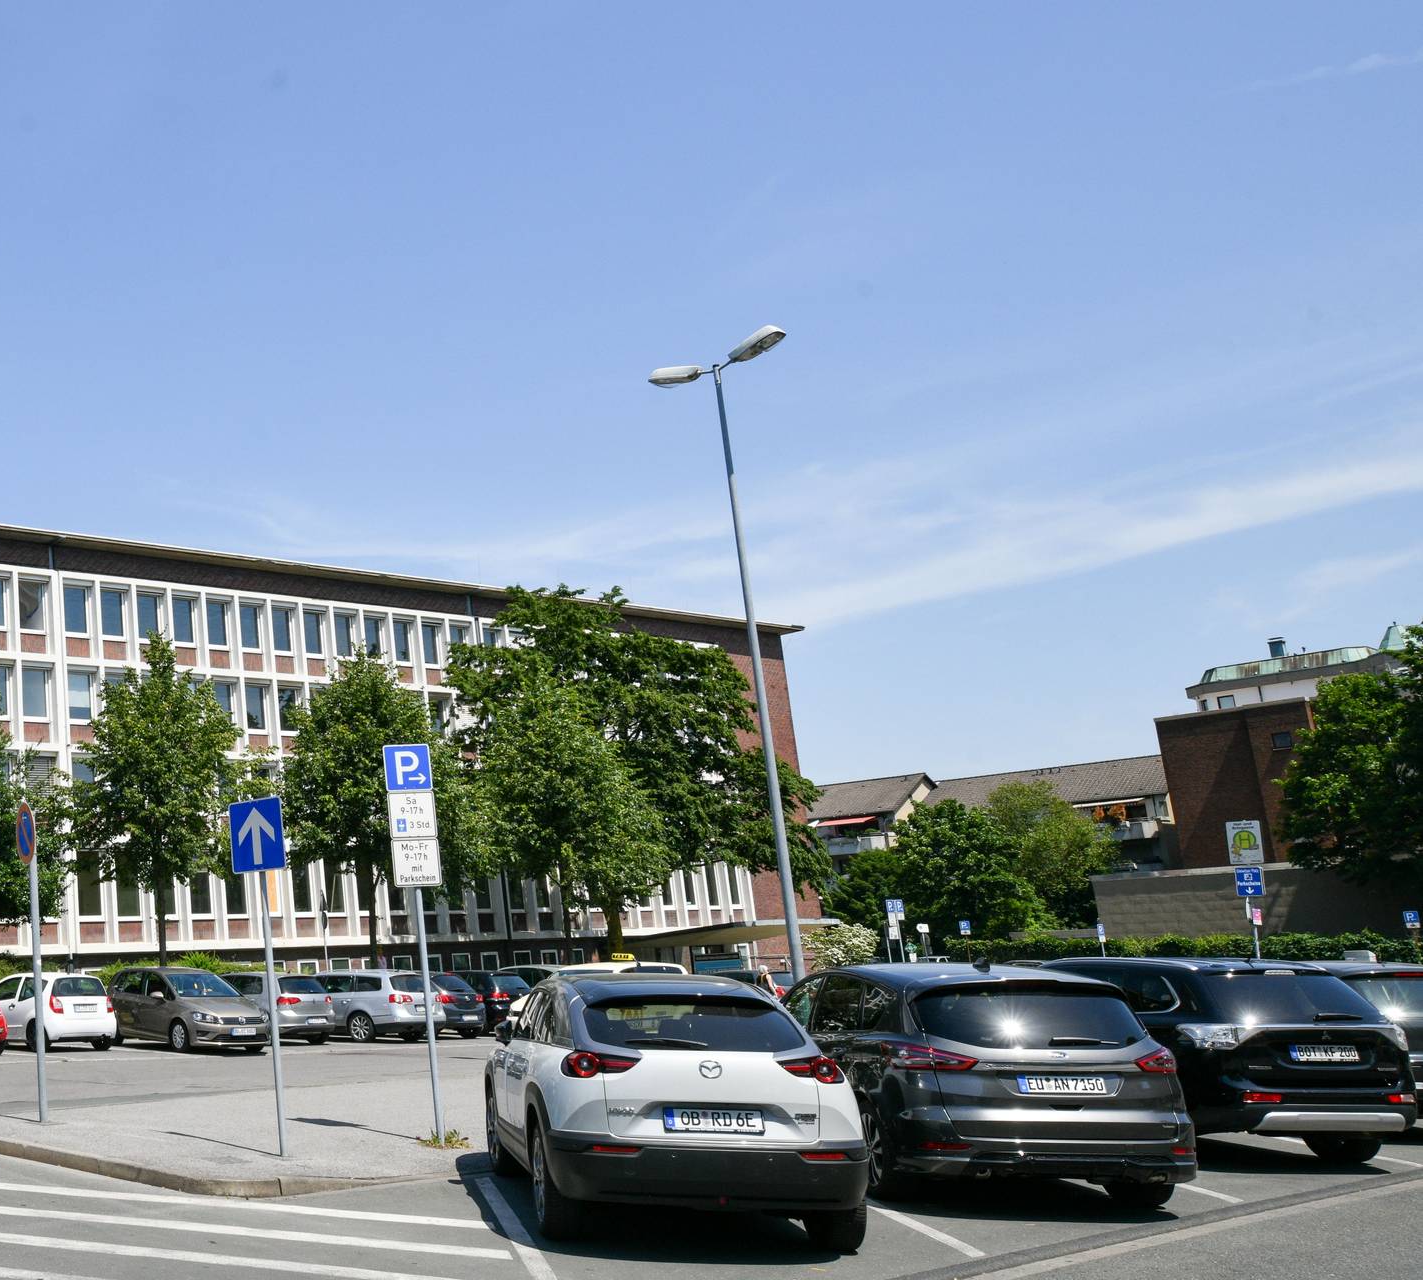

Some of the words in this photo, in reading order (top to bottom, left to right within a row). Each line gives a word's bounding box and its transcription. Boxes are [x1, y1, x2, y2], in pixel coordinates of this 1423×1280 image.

[394, 751, 419, 785] P
[400, 874, 436, 883] Parkschein
[1297, 1046, 1320, 1057] BOT
[1323, 1046, 1339, 1057] KF
[1339, 1046, 1357, 1058] 200
[1029, 1077, 1045, 1090] EU
[1055, 1078, 1070, 1091] AN
[1072, 1078, 1104, 1091] 7150
[681, 1111, 701, 1126] OB
[711, 1112, 732, 1127] RD
[737, 1112, 756, 1128] 6E
